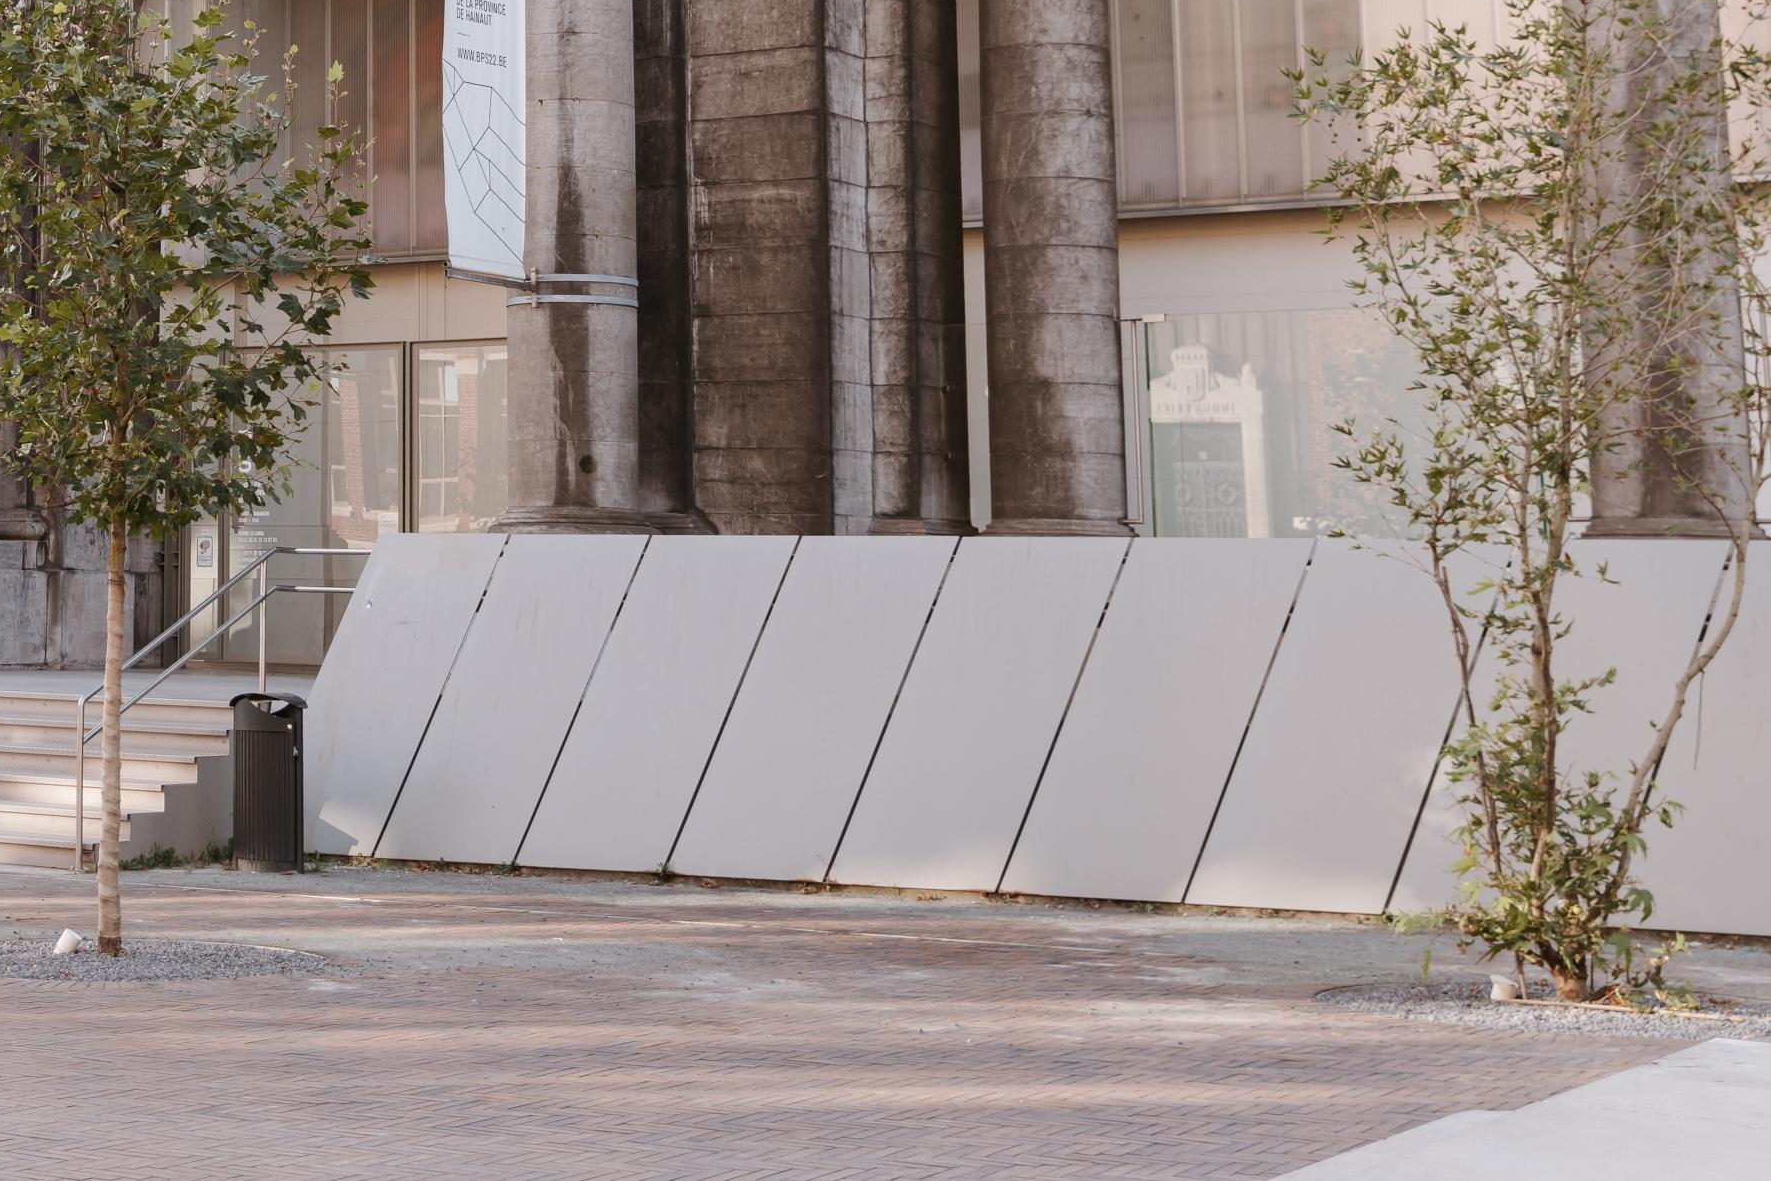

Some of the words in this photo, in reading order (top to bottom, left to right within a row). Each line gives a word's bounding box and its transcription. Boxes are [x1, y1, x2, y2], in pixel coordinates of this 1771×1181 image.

[475, 0, 506, 15] PROVINCE
[457, 8, 464, 20] DE
[466, 10, 492, 25] HAINAUT
[457, 47, 507, 67] WWW.BPS22.BE
